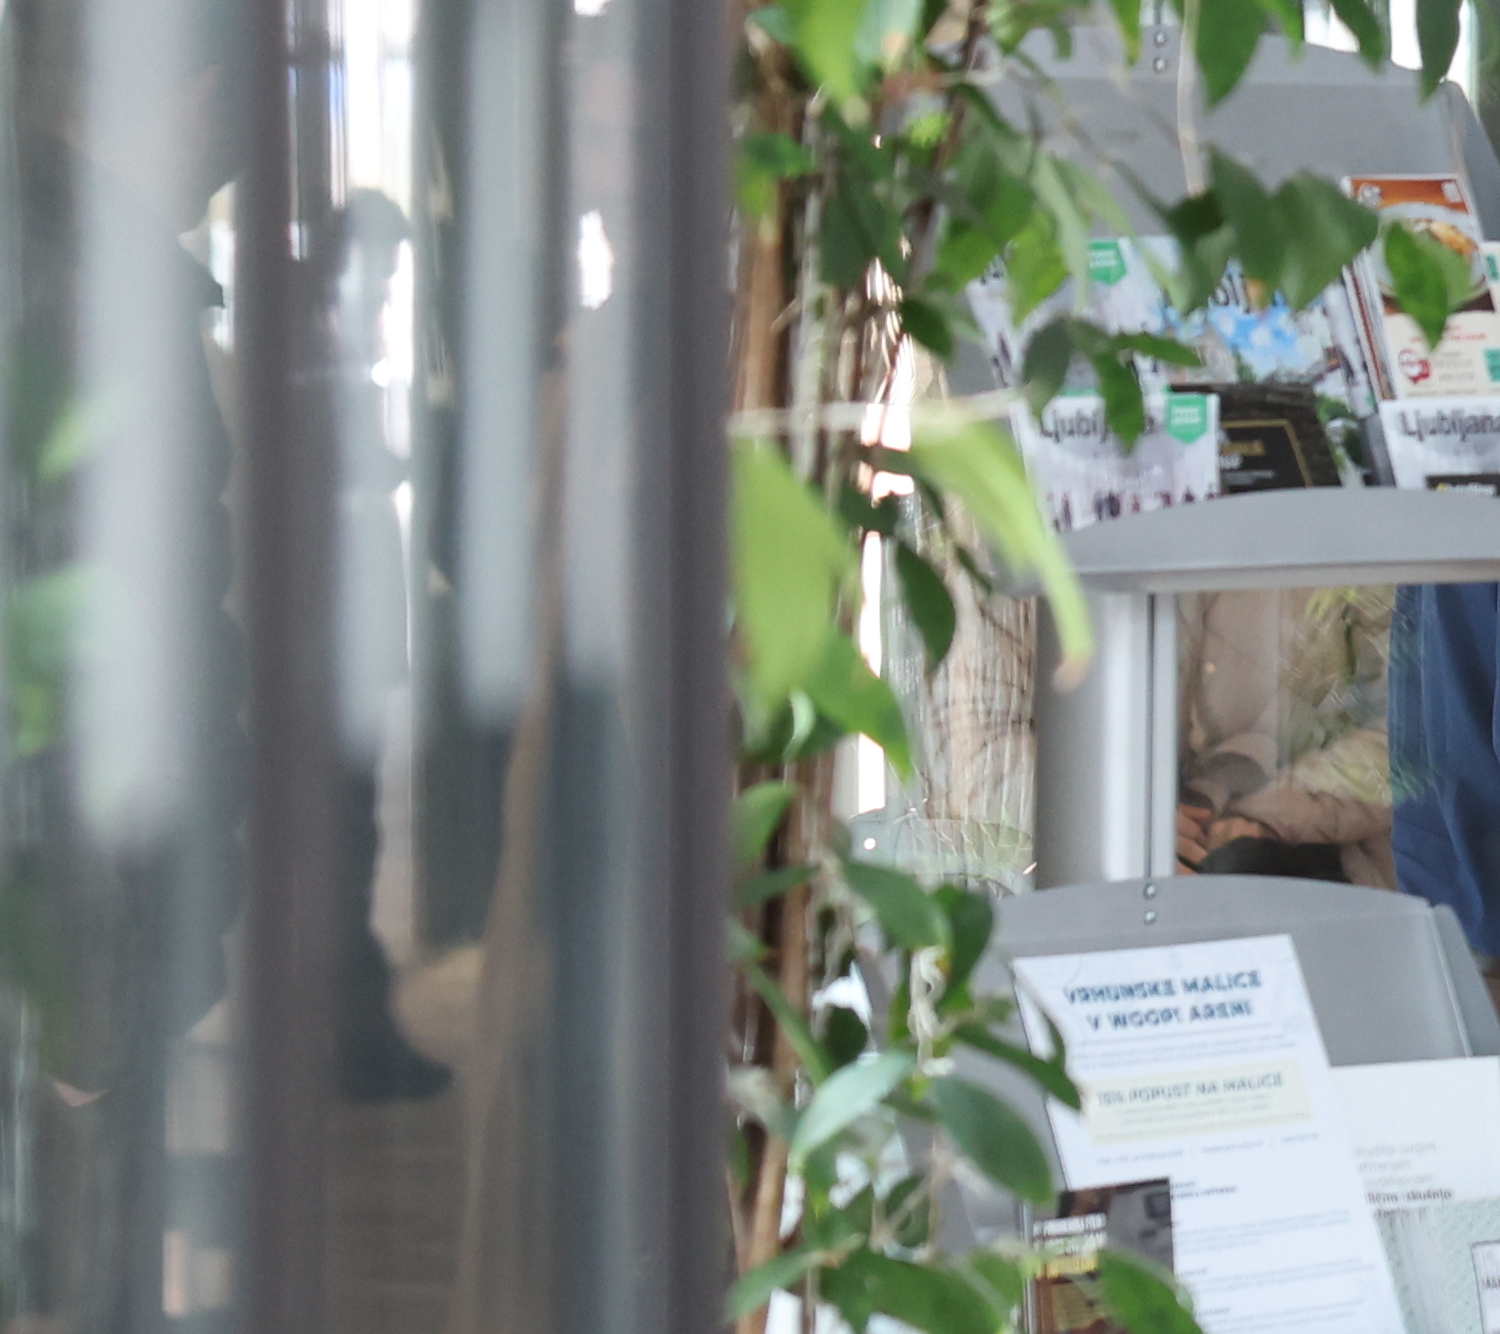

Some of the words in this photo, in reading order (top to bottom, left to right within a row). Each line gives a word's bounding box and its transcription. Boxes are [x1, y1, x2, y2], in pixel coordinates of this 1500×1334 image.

[1181, 969, 1263, 994] MALICE
[1087, 1013, 1101, 1031] V
[1189, 999, 1253, 1019] ARENI
[1128, 1082, 1192, 1104] POPUST
[1195, 1080, 1219, 1095] NA
[1222, 1071, 1284, 1093] MALICE
